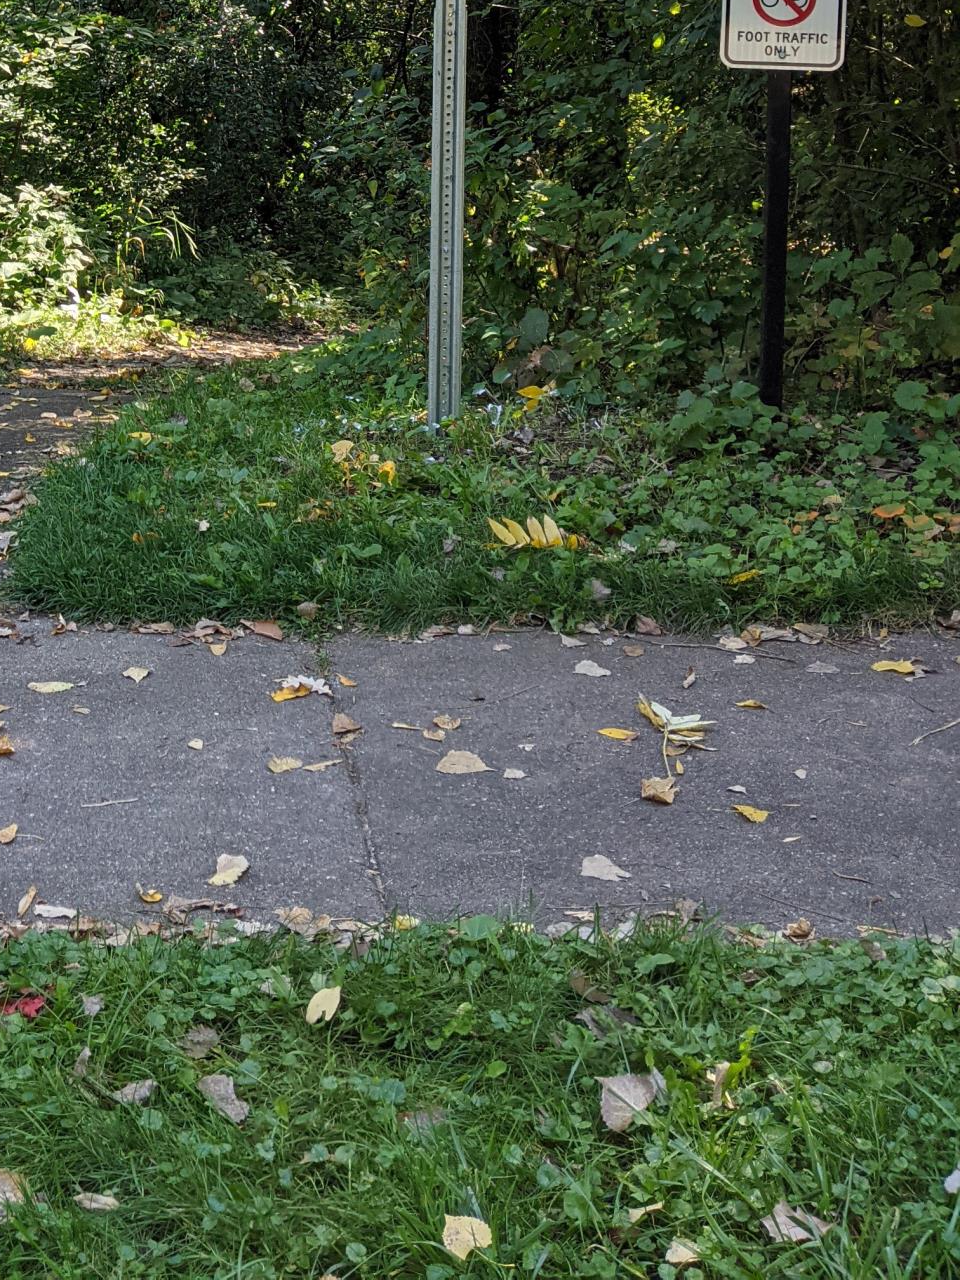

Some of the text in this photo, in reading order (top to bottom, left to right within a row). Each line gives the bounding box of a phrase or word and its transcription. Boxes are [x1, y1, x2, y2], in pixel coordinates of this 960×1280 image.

[737, 31, 828, 44] FOOT TRAFFIC
[765, 45, 800, 57] ONLY
